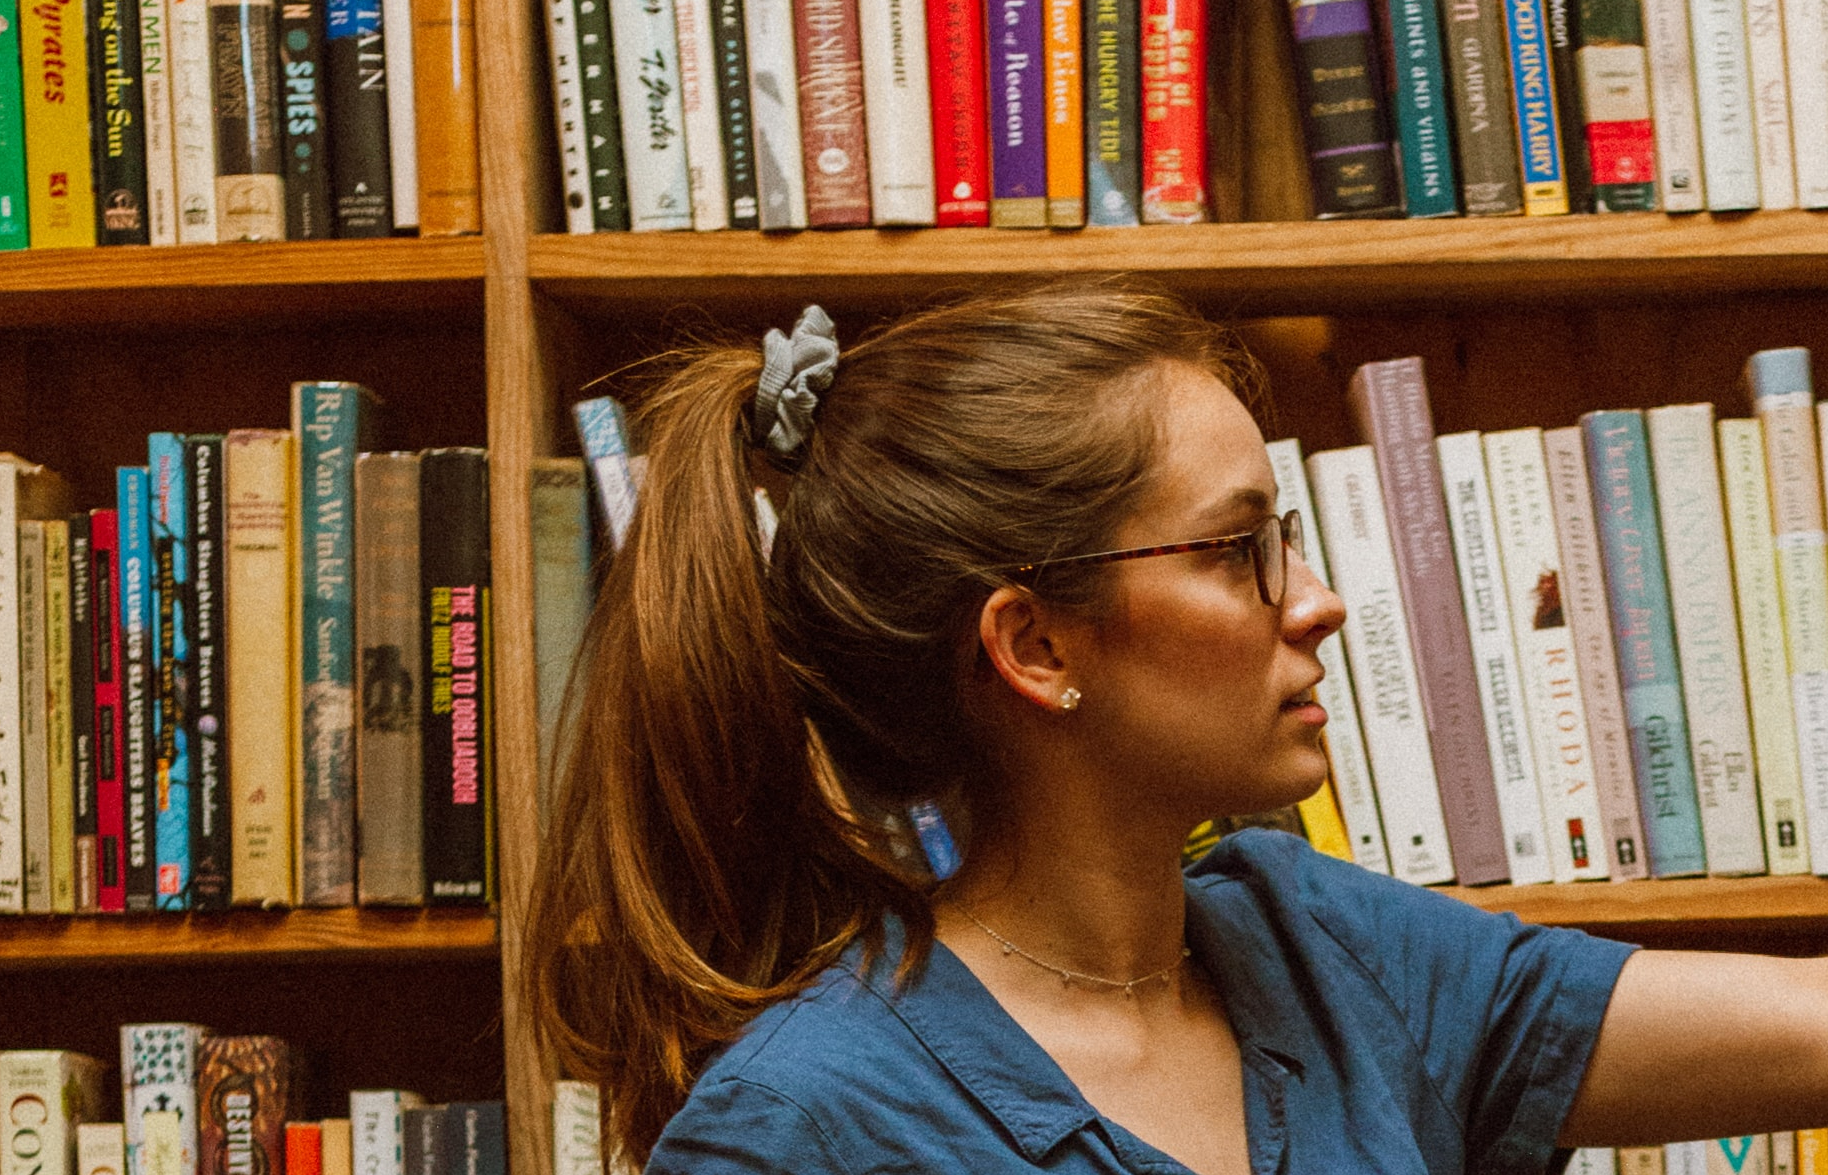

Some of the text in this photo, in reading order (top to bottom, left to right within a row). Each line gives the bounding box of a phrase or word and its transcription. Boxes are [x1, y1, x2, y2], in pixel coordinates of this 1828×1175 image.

[103, 35, 134, 158] on the Sun
[142, 15, 161, 75] MEN
[1097, 29, 1122, 164] HUNGRY TIDE
[1171, 29, 1195, 76] Sea
[1460, 37, 1490, 134] GIARDINA
[284, 60, 318, 136] SPIES
[1005, 52, 1029, 147] Reason
[1519, 43, 1553, 177] KING HARRY
[305, 391, 346, 601] Rip Van Winkle
[1559, 449, 1579, 504] Ellen
[1603, 427, 1636, 520] Victory
[196, 445, 214, 708] Columbus Slaughters Braves
[1618, 528, 1645, 596] Over
[451, 584, 477, 694] THE ROAD TO
[126, 556, 146, 867] COLUMBUS SLAUGHTERS BRAVES
[1544, 648, 1588, 796] RHODA
[1643, 715, 1678, 820] Gilchrist
